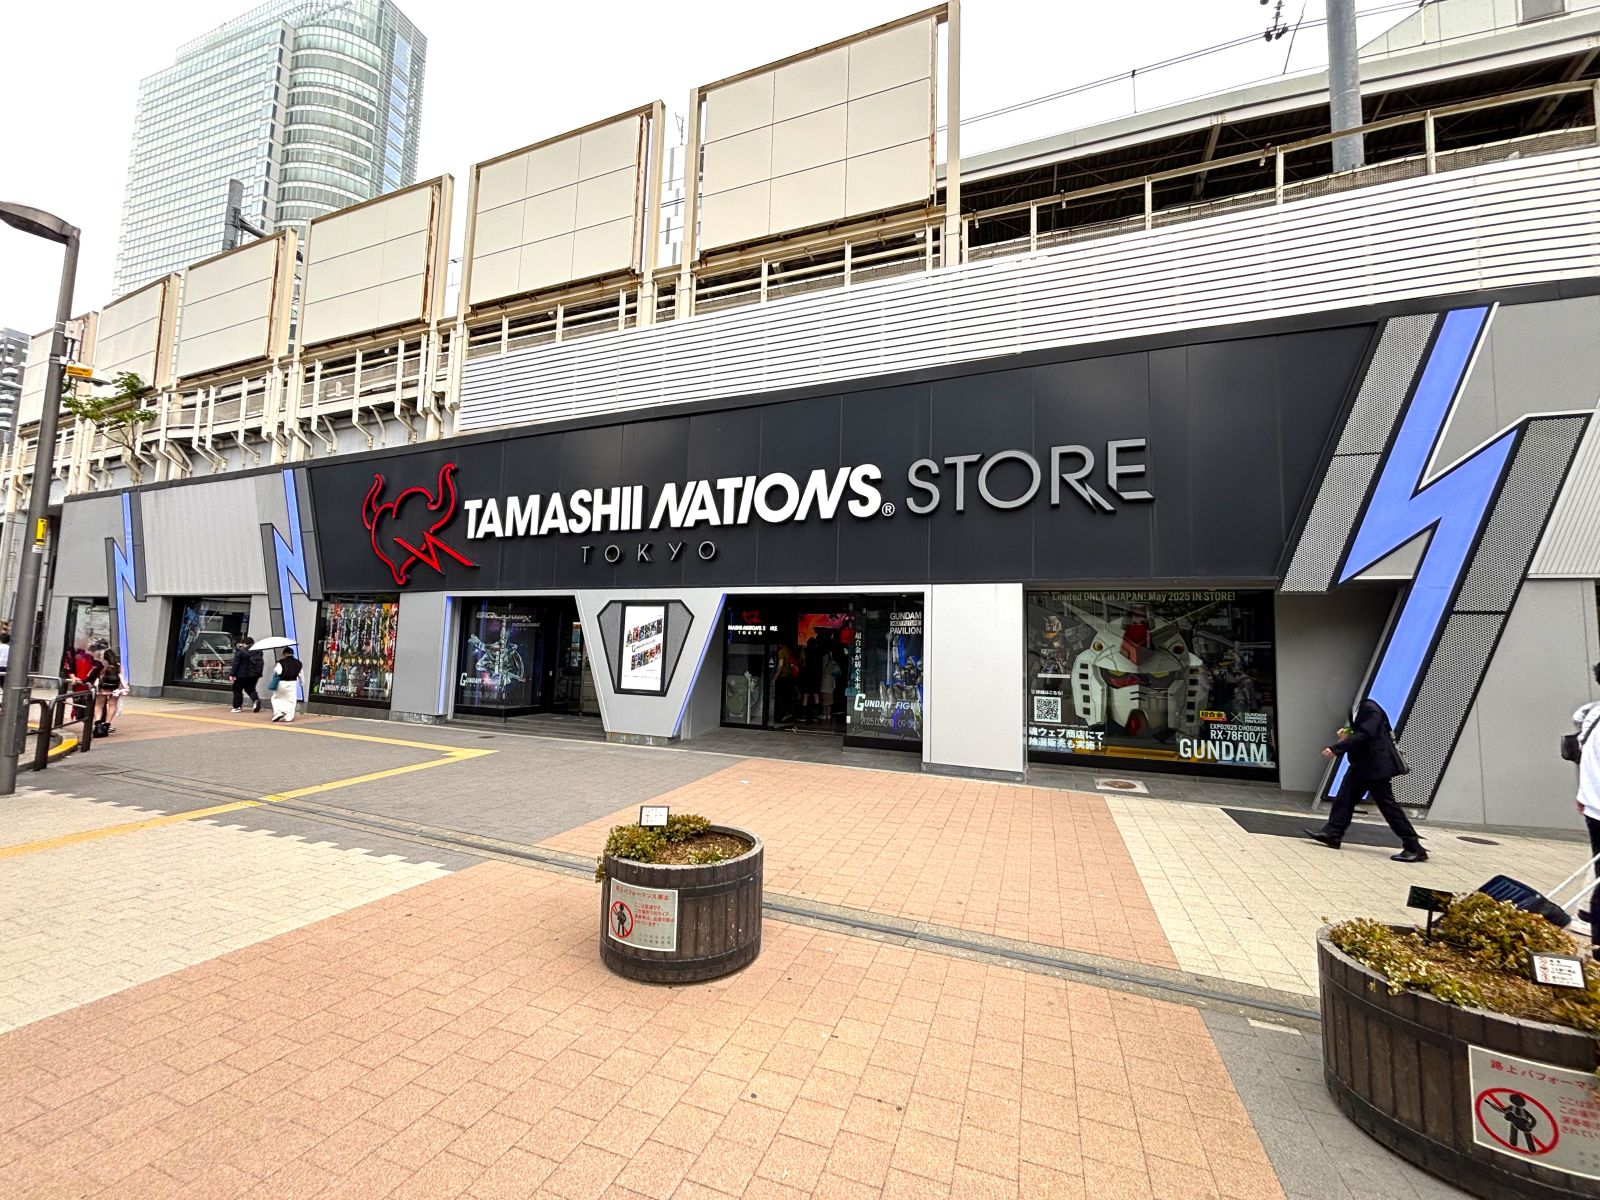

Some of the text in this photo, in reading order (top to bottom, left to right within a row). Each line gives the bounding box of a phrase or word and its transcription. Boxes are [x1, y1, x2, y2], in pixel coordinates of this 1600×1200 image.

[464, 485, 643, 539] TAMASHII
[906, 438, 1154, 514] STORE
[581, 541, 716, 564] TOKYO
[1083, 591, 1106, 601] ONLY
[1116, 591, 1147, 601] JAPAN!
[1148, 592, 1167, 603] May
[1168, 591, 1191, 602] 2025
[1192, 592, 1203, 601] IN
[1204, 592, 1236, 602] STORE!
[889, 611, 922, 620] GUNDAM
[889, 627, 922, 635] PAVILION
[853, 693, 892, 712] GUNDAM
[1179, 738, 1268, 763] GUNDAM
